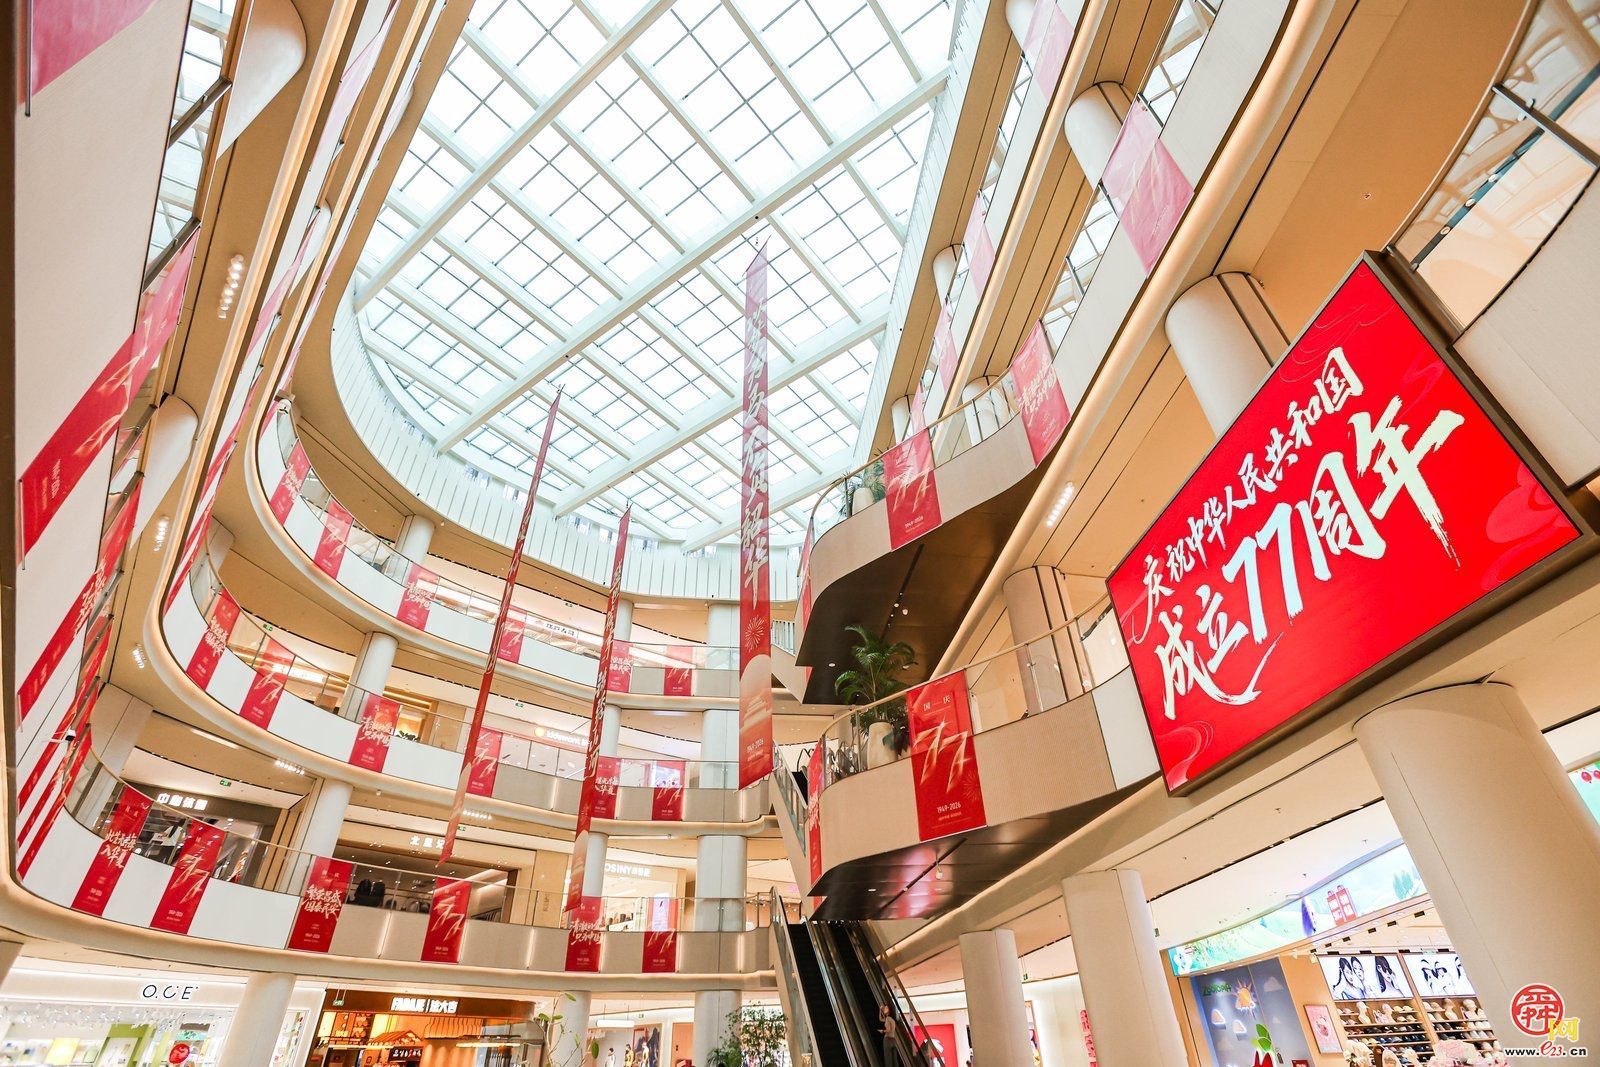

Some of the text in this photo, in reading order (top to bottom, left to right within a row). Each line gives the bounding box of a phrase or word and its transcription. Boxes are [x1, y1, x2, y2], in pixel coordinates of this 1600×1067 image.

[1132, 346, 1364, 644] 庆祝中华人民共和国
[1153, 396, 1465, 720] 成立77周年
[922, 695, 951, 712] 国庆
[913, 716, 974, 794] 77
[936, 802, 962, 814] 1949-2026
[100, 844, 128, 868] 入华夏
[170, 854, 210, 905] 77
[304, 901, 340, 921] 国泰民安
